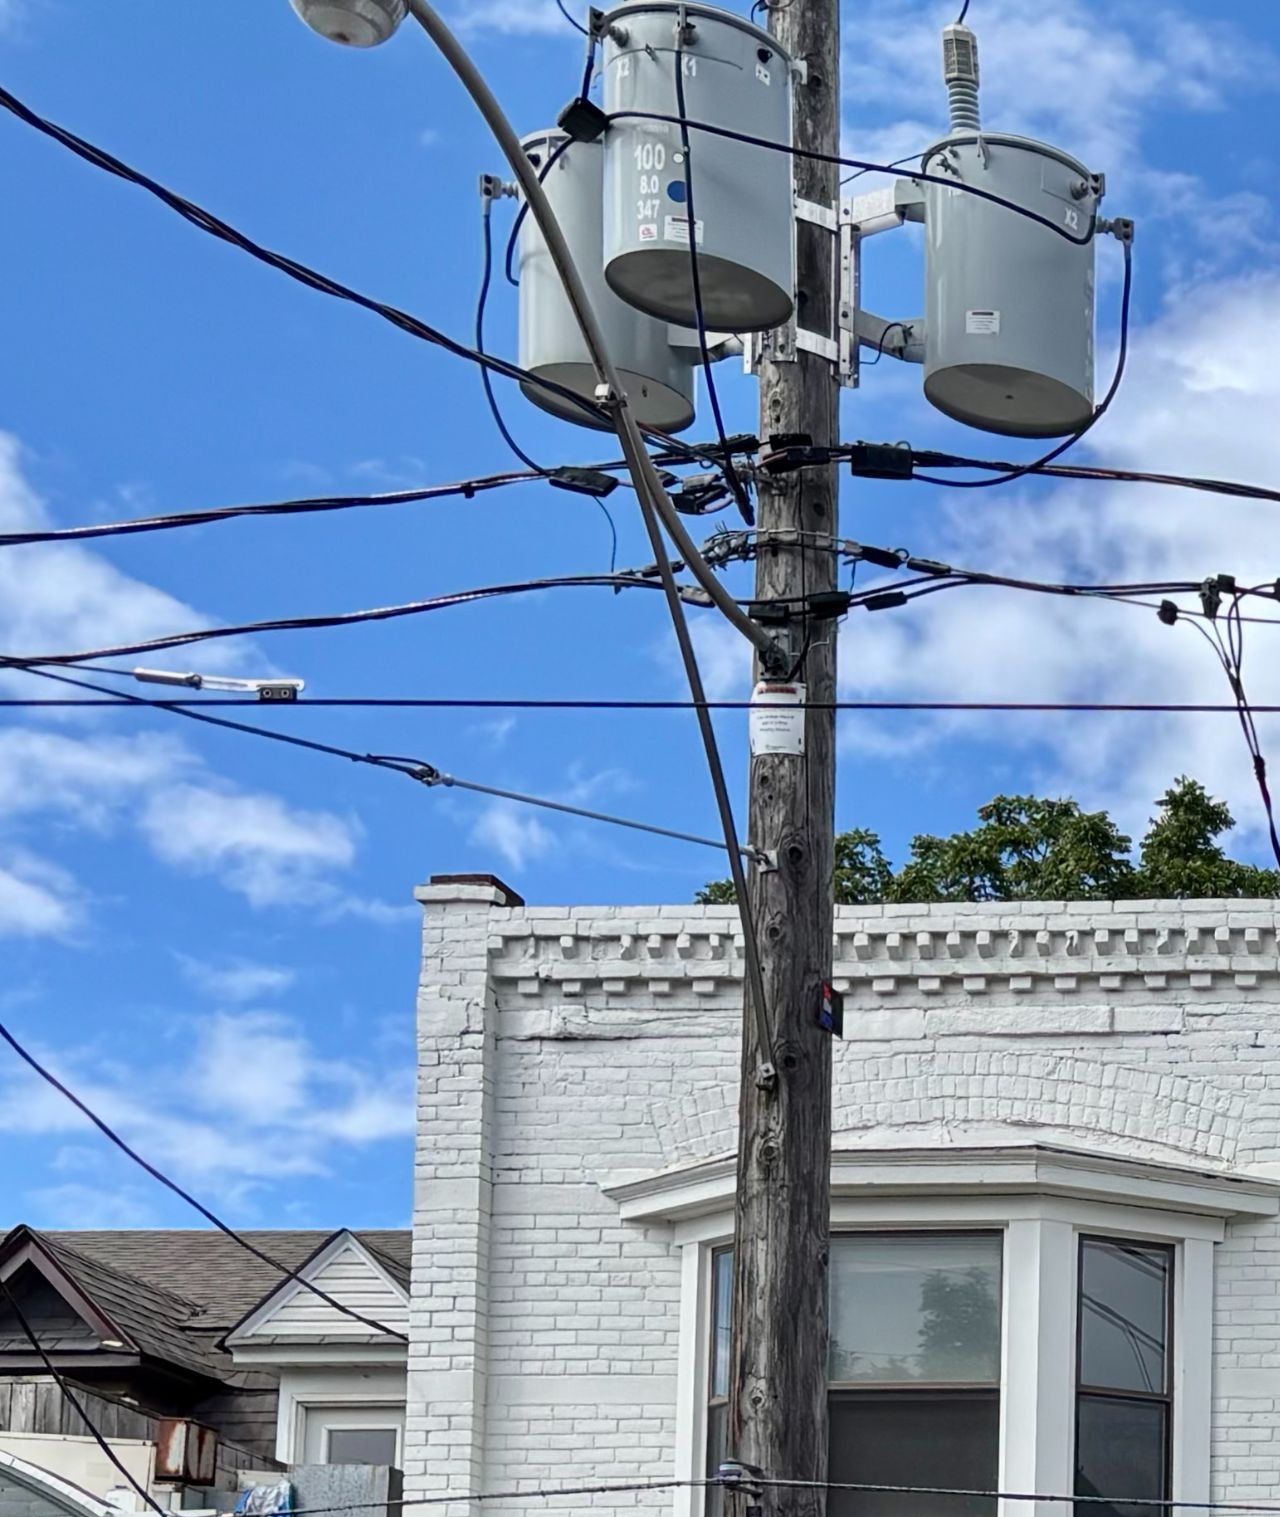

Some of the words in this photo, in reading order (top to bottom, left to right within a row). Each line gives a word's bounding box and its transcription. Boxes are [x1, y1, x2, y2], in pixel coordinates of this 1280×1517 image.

[634, 143, 666, 171] 100
[639, 174, 660, 195] 8.0
[636, 199, 661, 220] 347
